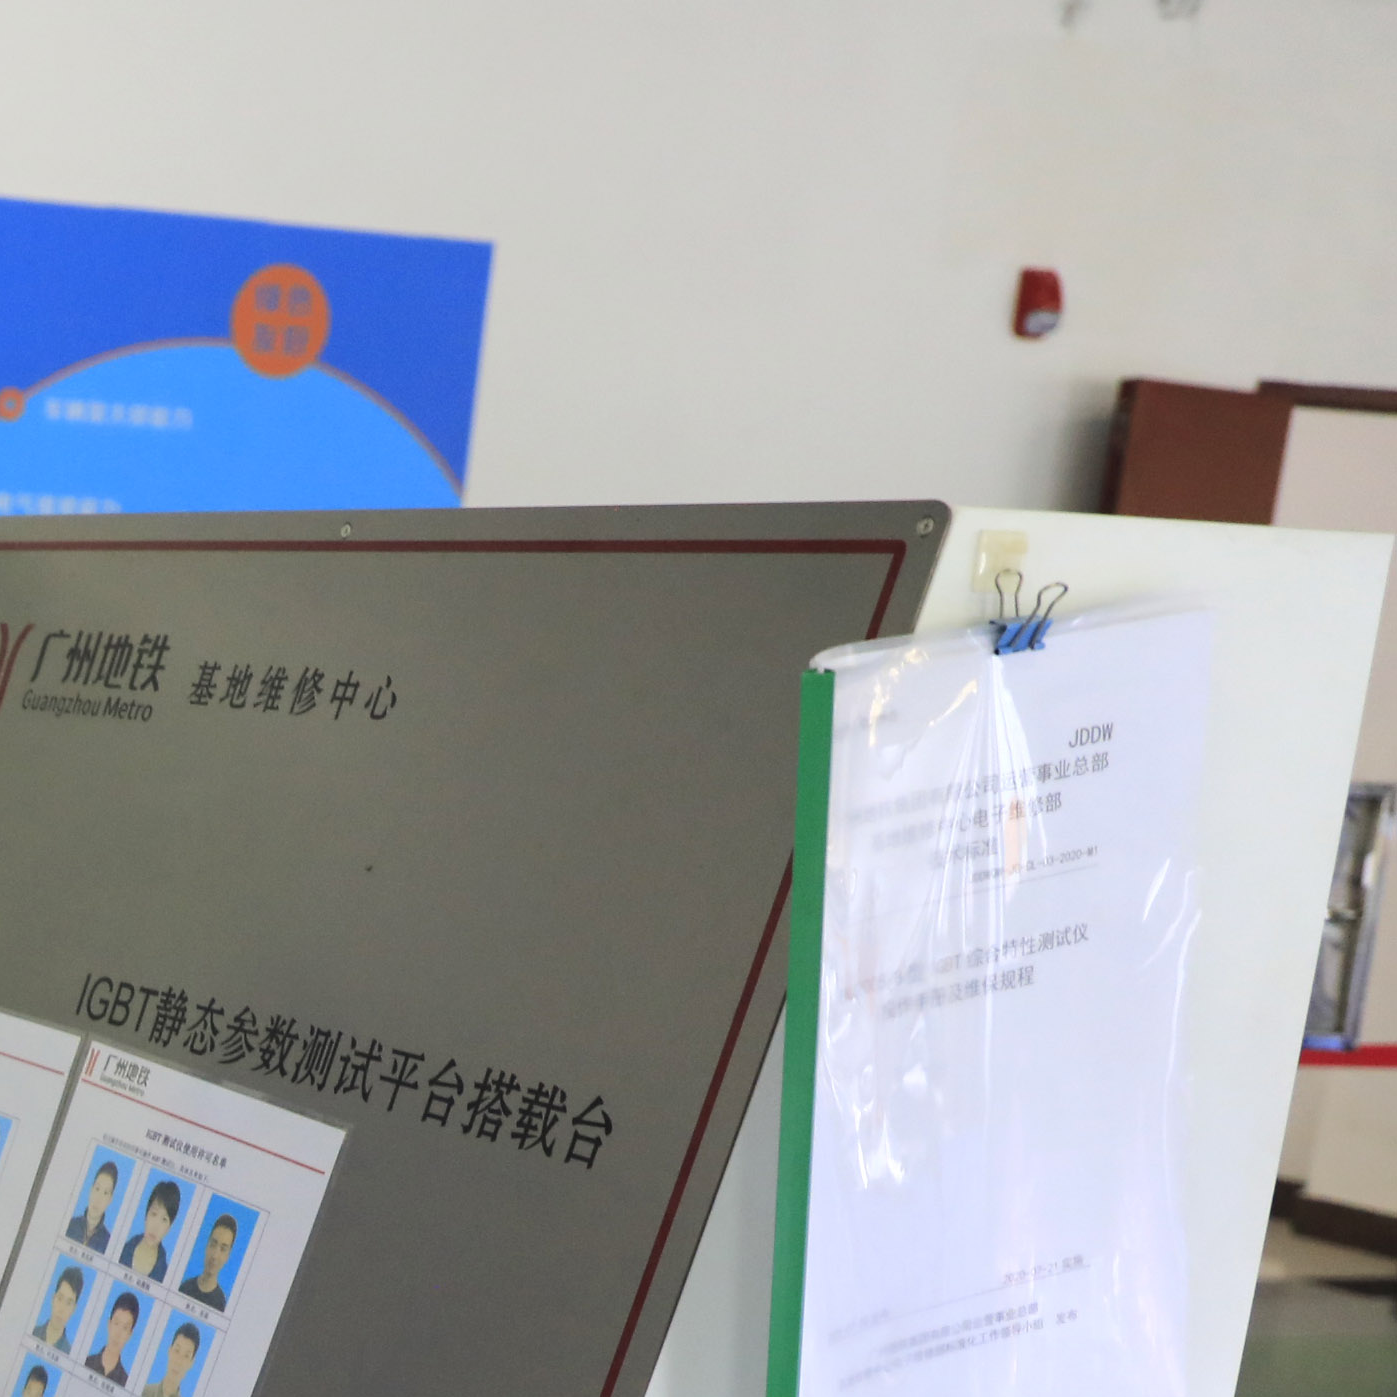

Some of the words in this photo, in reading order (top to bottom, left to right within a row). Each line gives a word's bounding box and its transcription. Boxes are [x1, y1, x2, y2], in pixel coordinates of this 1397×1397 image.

[30, 629, 171, 692] 广州地铁
[189, 659, 398, 721] 基地维修中心
[22, 689, 100, 719] Guangzhou
[103, 700, 153, 723] Metro
[1068, 722, 1114, 748] JDDW
[74, 972, 613, 1170] IGBT静态参数测试平台搭载台
